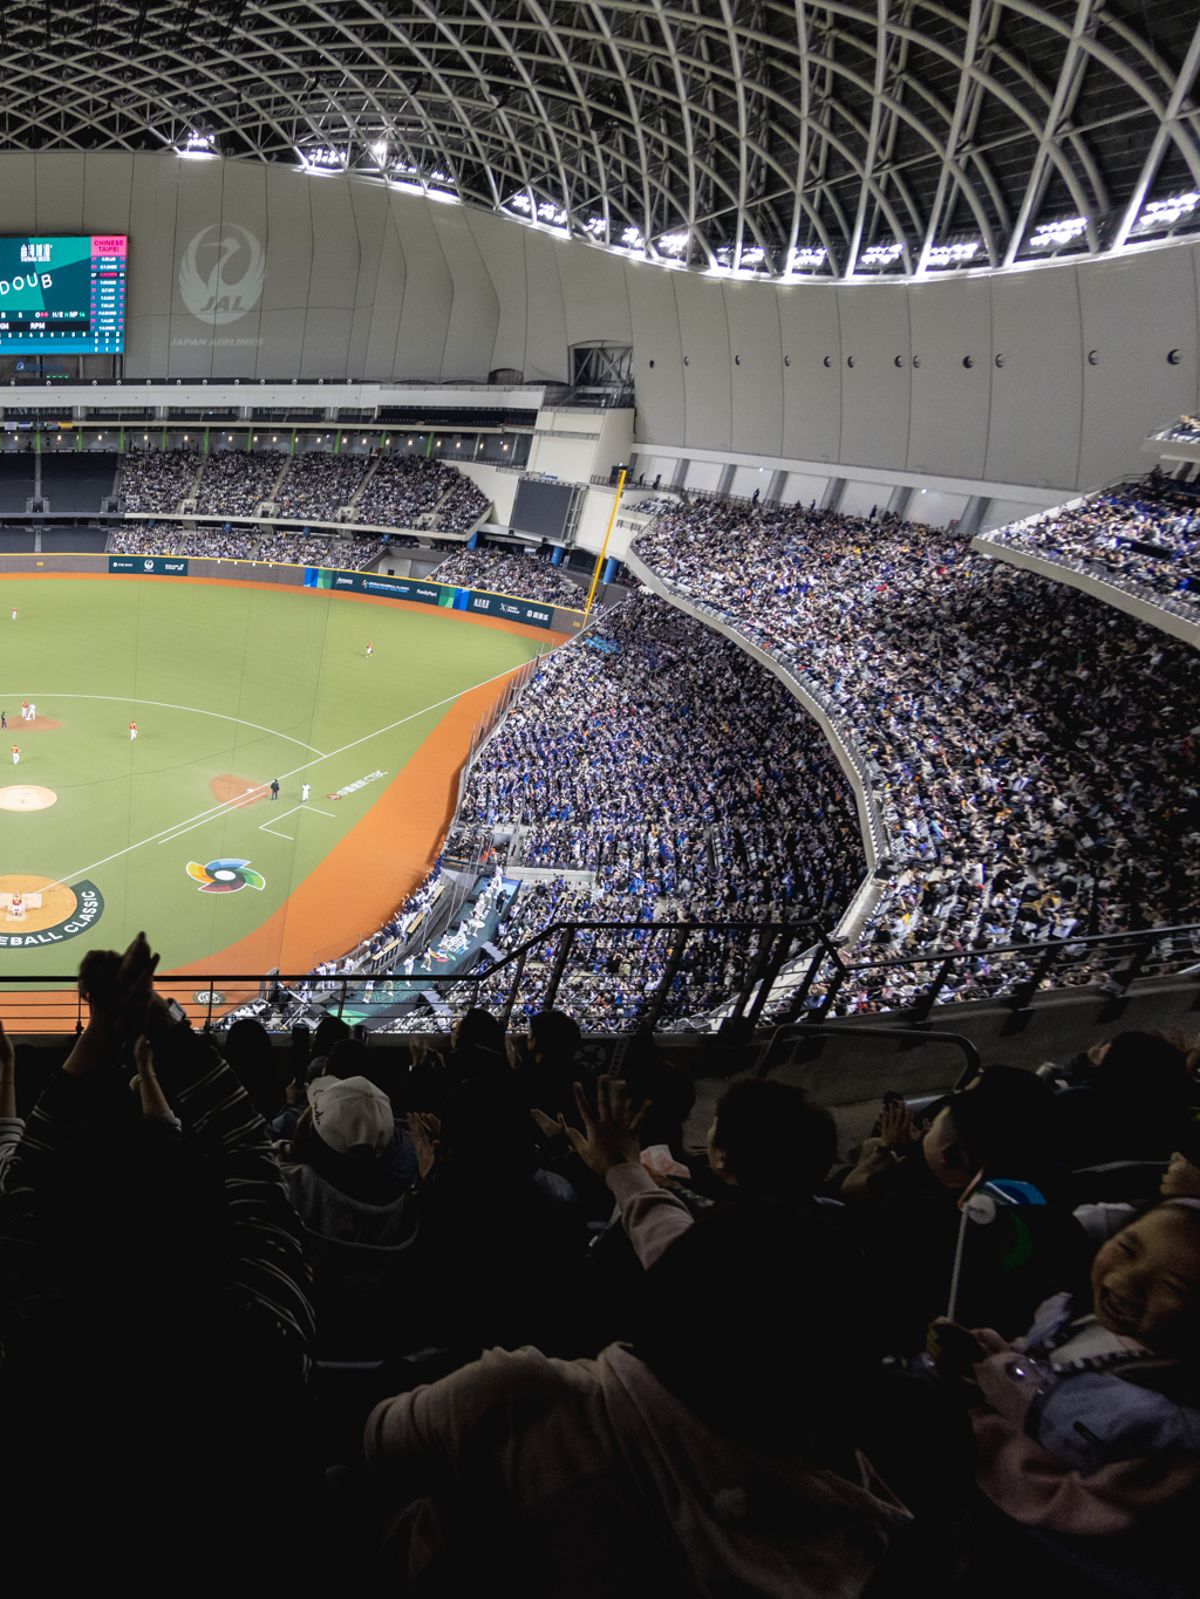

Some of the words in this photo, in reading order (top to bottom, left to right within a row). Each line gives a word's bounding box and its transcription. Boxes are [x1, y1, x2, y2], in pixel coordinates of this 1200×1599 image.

[200, 295, 245, 312] JAL
[30, 322, 45, 330] RPM
[171, 338, 208, 346] JAPAN
[210, 337, 263, 346] AIRLINES
[64, 890, 99, 934] CLASSIC
